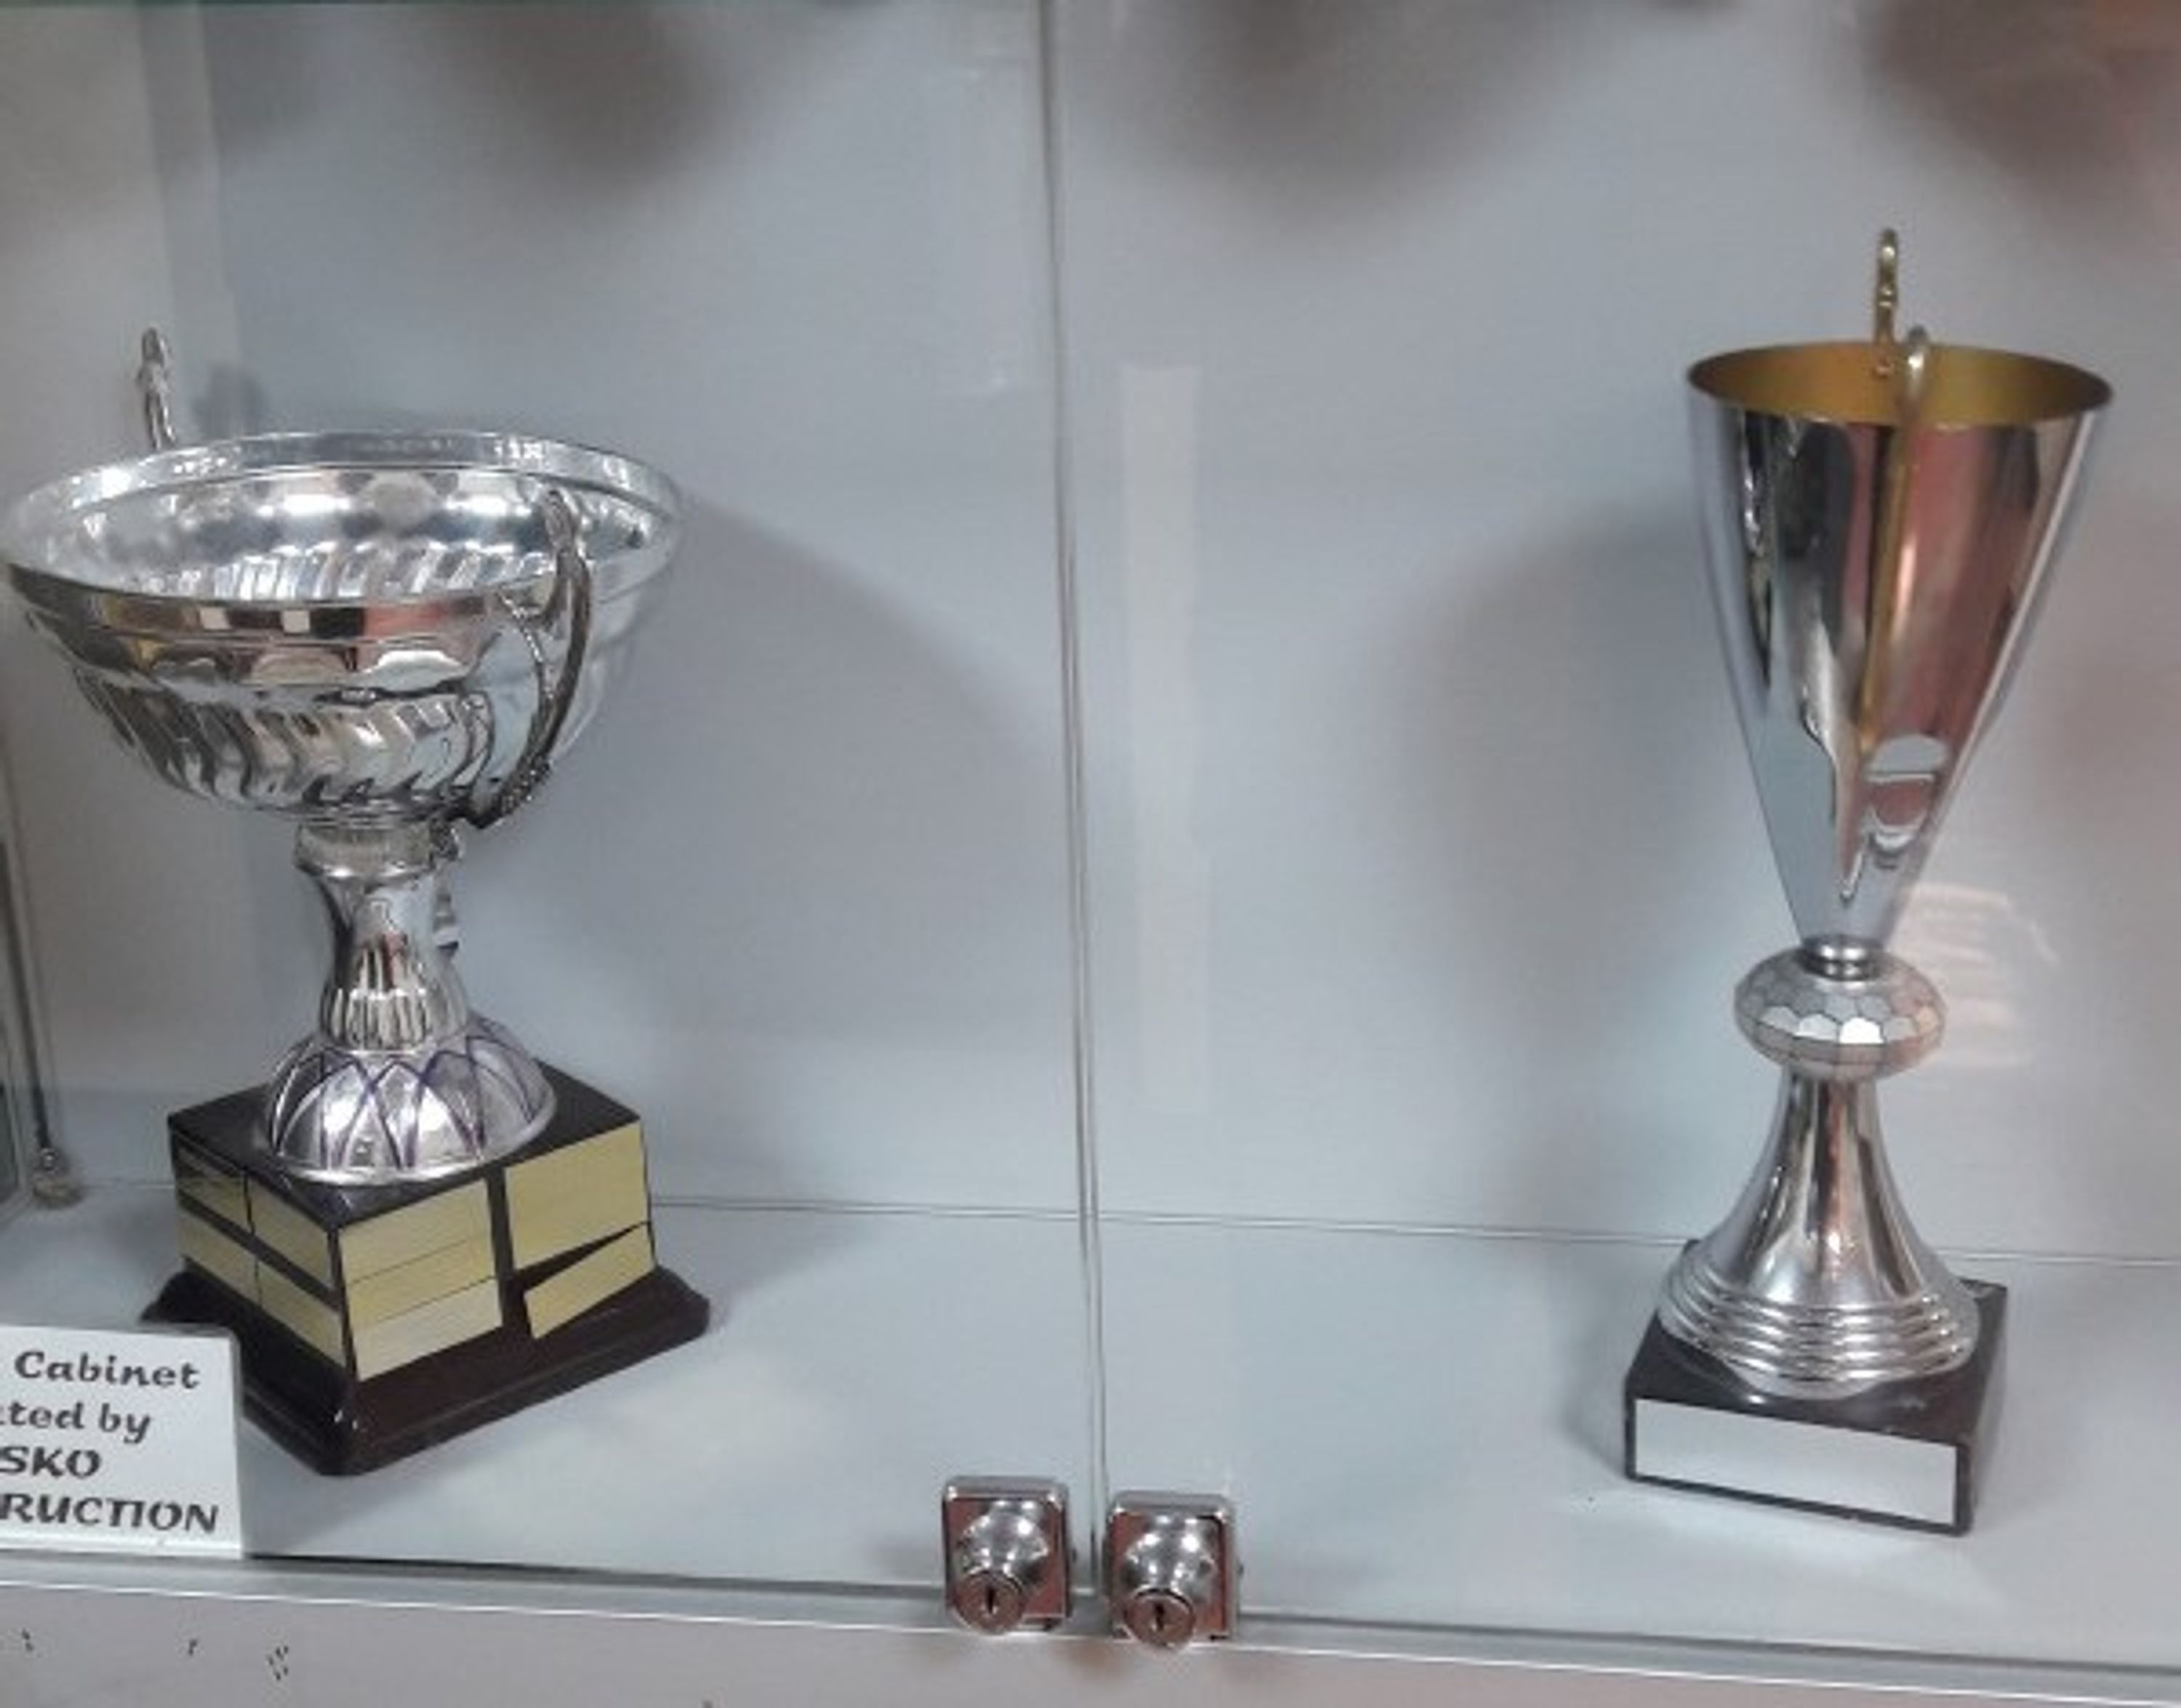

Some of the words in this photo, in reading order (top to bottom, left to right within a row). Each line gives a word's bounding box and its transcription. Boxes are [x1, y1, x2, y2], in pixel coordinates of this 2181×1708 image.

[15, 1350, 201, 1389] Cabinet
[0, 1401, 84, 1429] ted
[99, 1402, 151, 1444] by
[0, 1445, 101, 1478] SKO
[0, 1492, 219, 1533] RUCTION
